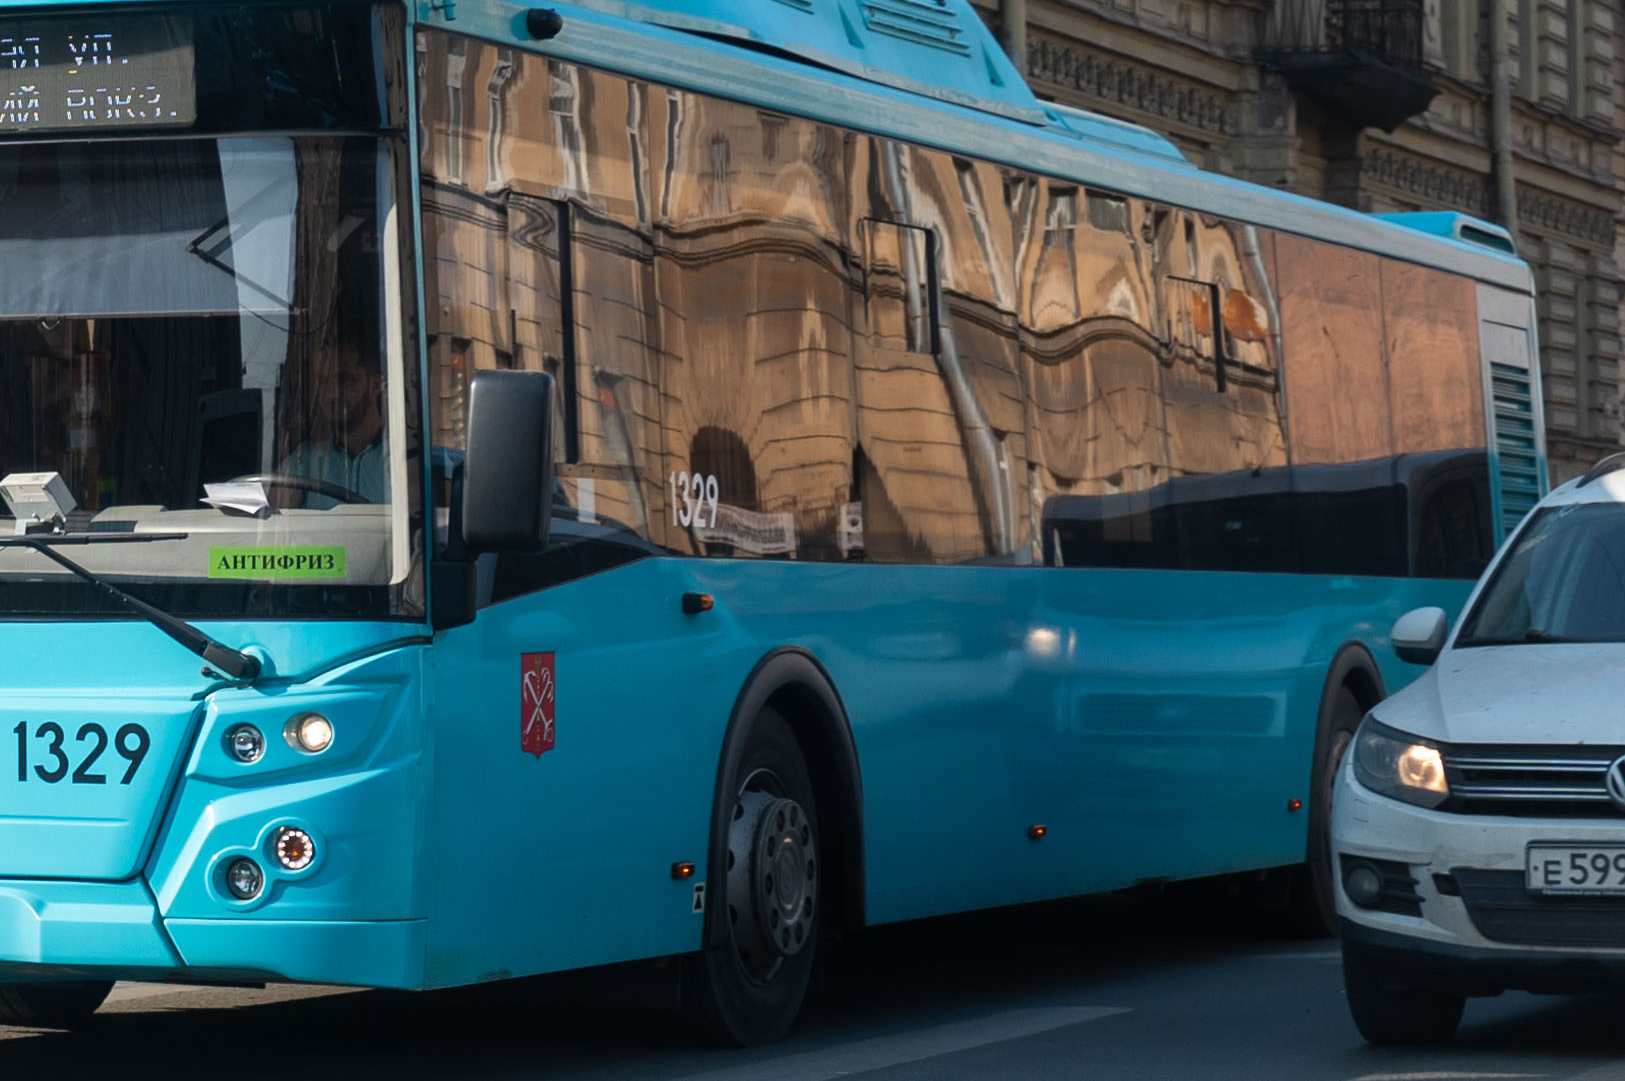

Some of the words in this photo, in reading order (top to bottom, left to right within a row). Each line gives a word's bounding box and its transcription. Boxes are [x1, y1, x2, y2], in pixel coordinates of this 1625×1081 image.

[670, 471, 718, 528] 1329
[217, 554, 335, 570] АНТИФРИЗ
[13, 720, 151, 785] 1329
